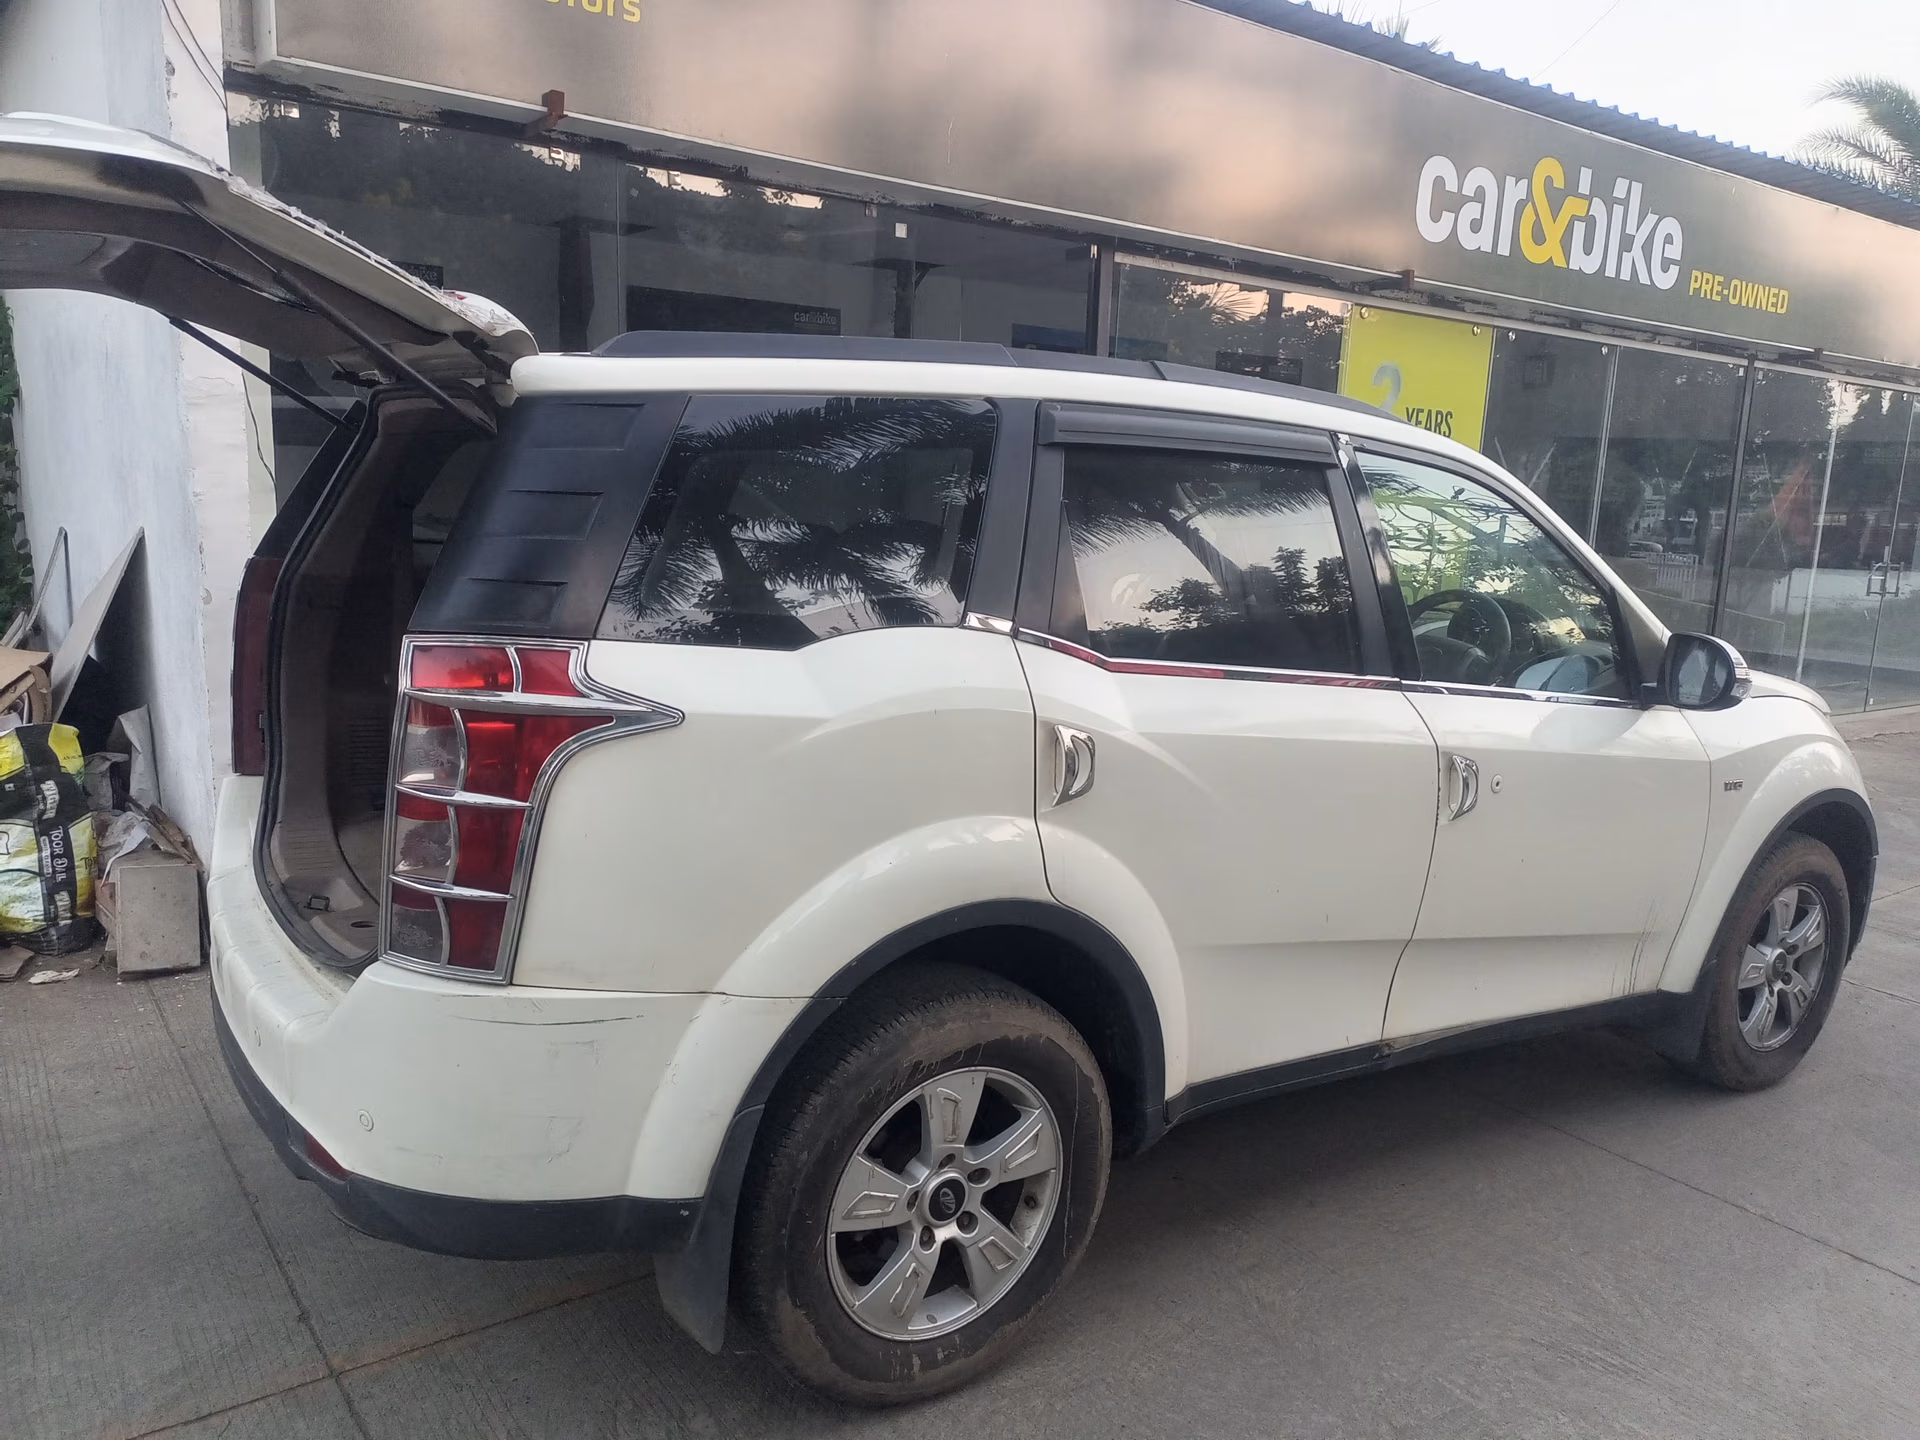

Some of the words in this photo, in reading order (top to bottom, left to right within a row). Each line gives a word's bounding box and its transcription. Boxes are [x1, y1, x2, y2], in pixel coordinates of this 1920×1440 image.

[1415, 155, 1683, 290] car&bike
[1689, 270, 1789, 315] PRE-OWNED
[1405, 406, 1454, 439] YEARS
[49, 825, 65, 856] TOOR
